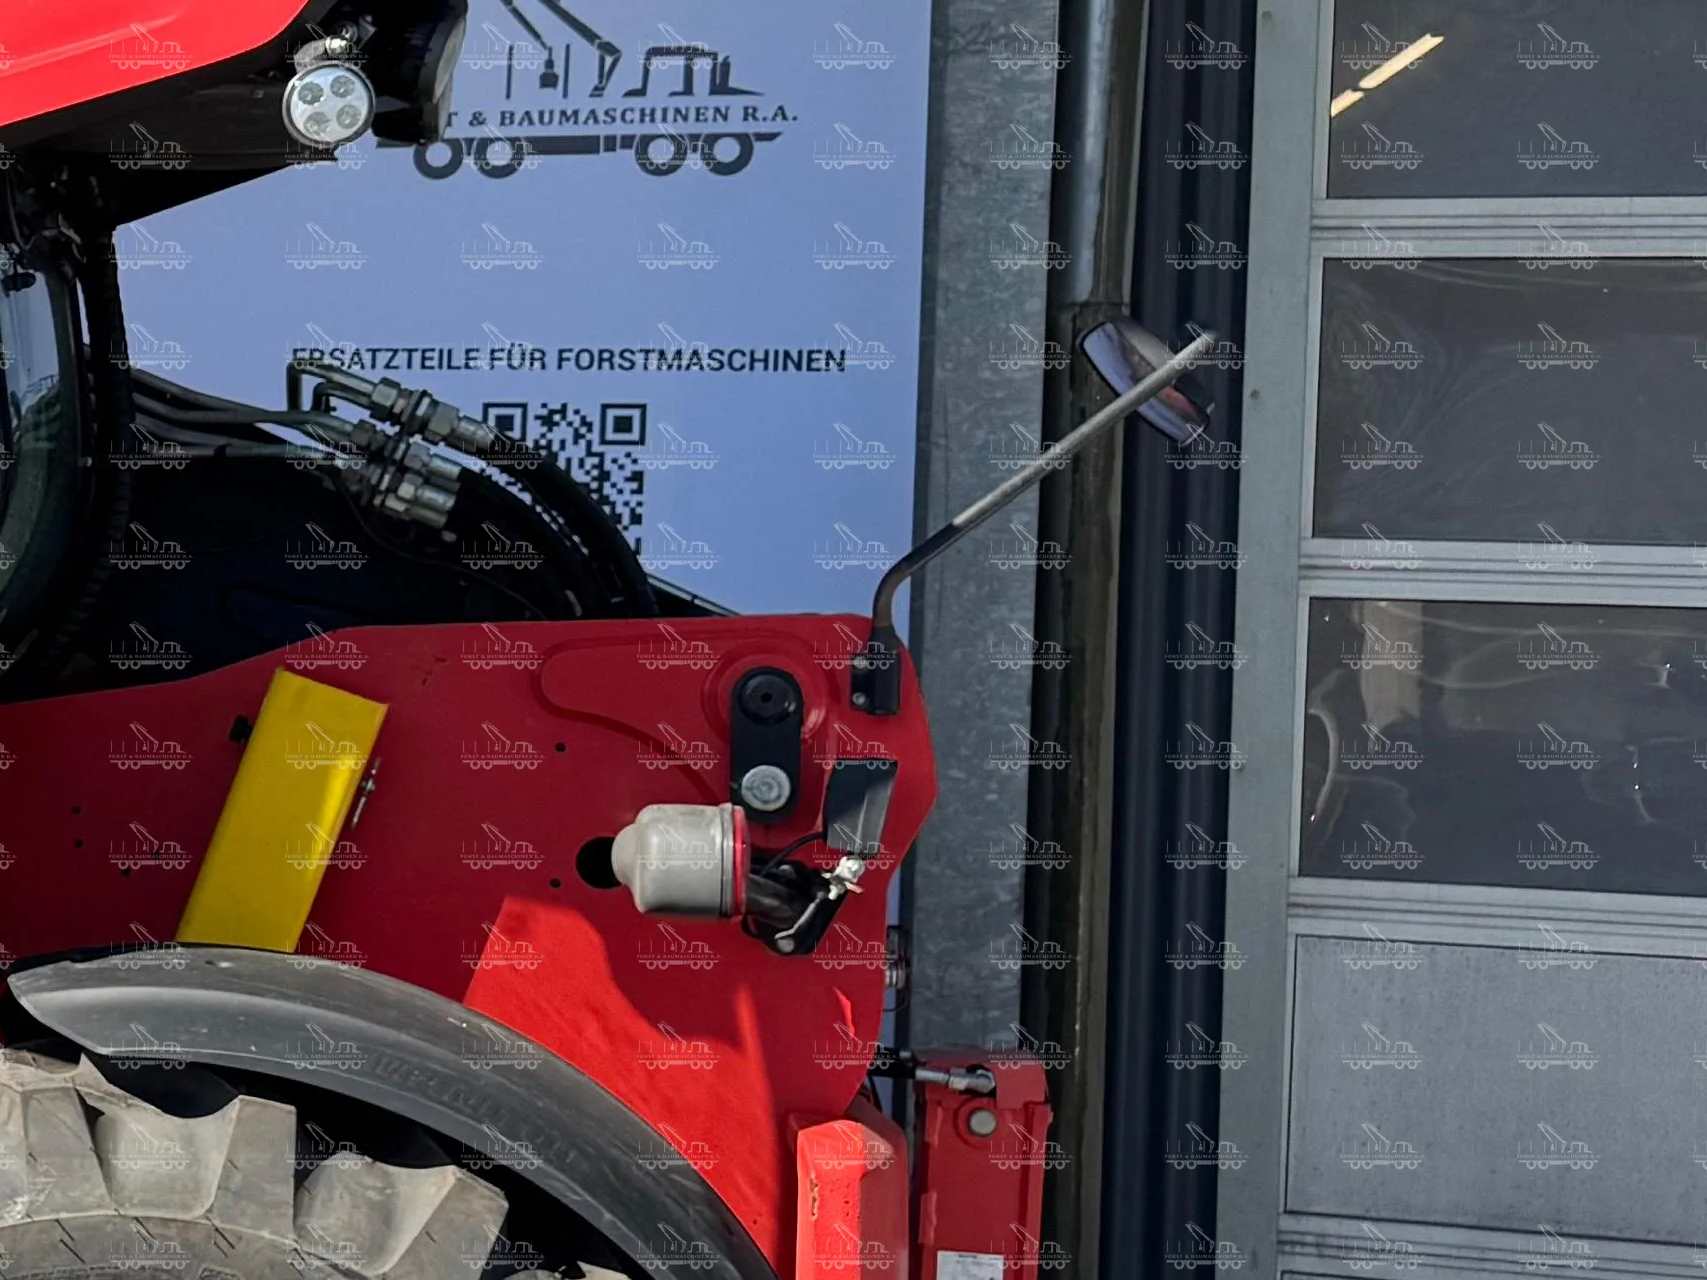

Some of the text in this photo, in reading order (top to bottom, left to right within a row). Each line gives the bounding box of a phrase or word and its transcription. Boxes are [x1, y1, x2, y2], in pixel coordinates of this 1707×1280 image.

[468, 112, 488, 127] &
[498, 105, 732, 128] BAUMASCHINEN
[741, 105, 799, 122] R.A.
[488, 343, 548, 371] FÜR
[556, 347, 847, 373] FORSTMASCHINEN
